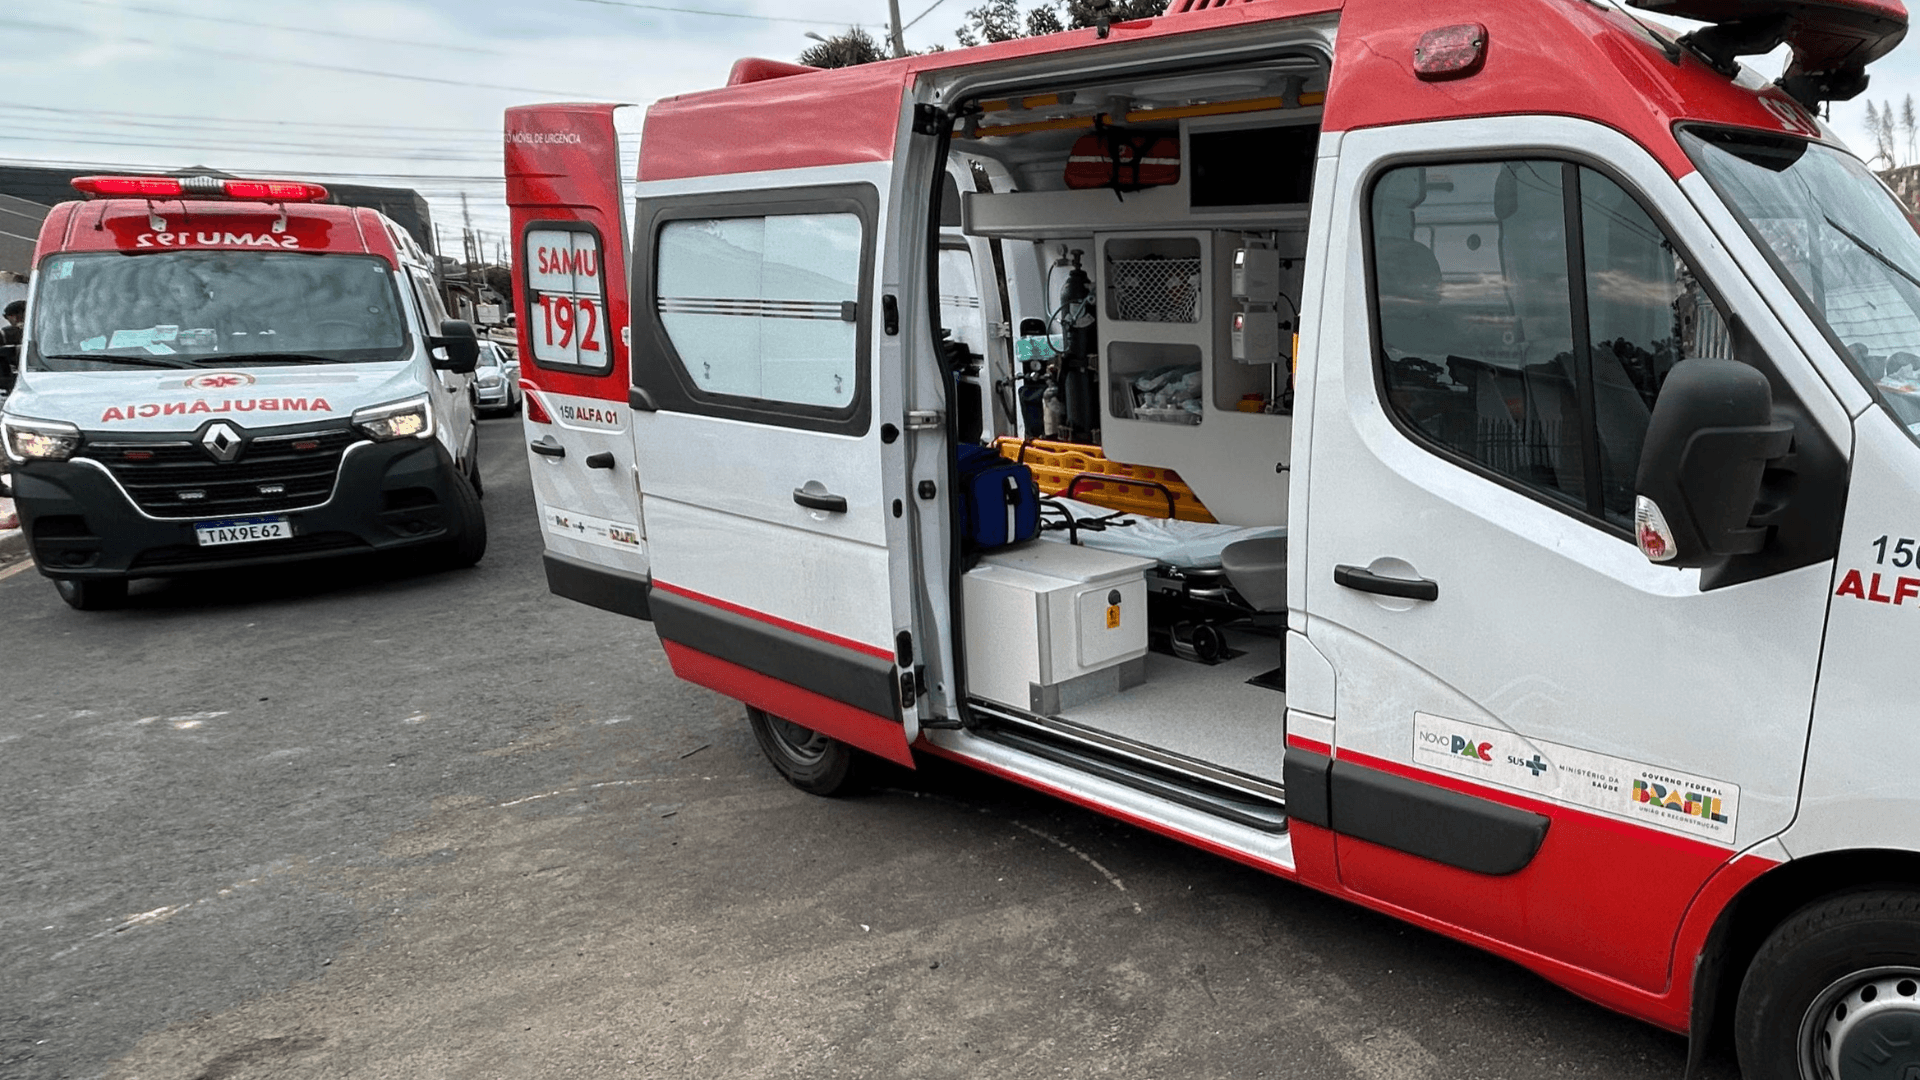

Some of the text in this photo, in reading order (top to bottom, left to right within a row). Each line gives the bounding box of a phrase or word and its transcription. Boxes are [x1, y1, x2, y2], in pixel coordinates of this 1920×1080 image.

[534, 133, 544, 144] DE
[544, 131, 581, 144] URGÊNCIA
[538, 246, 597, 277] SAMU
[538, 293, 600, 352] 192
[560, 405, 618, 425] 150 ALFA 01
[206, 524, 282, 543] TAX9E62
[1872, 535, 1920, 570] 15
[1835, 569, 1920, 609] ALF
[1419, 731, 1450, 747] NOVO
[1451, 734, 1493, 762] PAC
[1507, 755, 1525, 767] SUS
[1559, 764, 1619, 784] MINISTÉRIO DA
[1592, 780, 1618, 792] SAÚDE
[1641, 772, 1722, 796] GOVERNO FEDERAL
[1631, 779, 1728, 824] BRASIL
